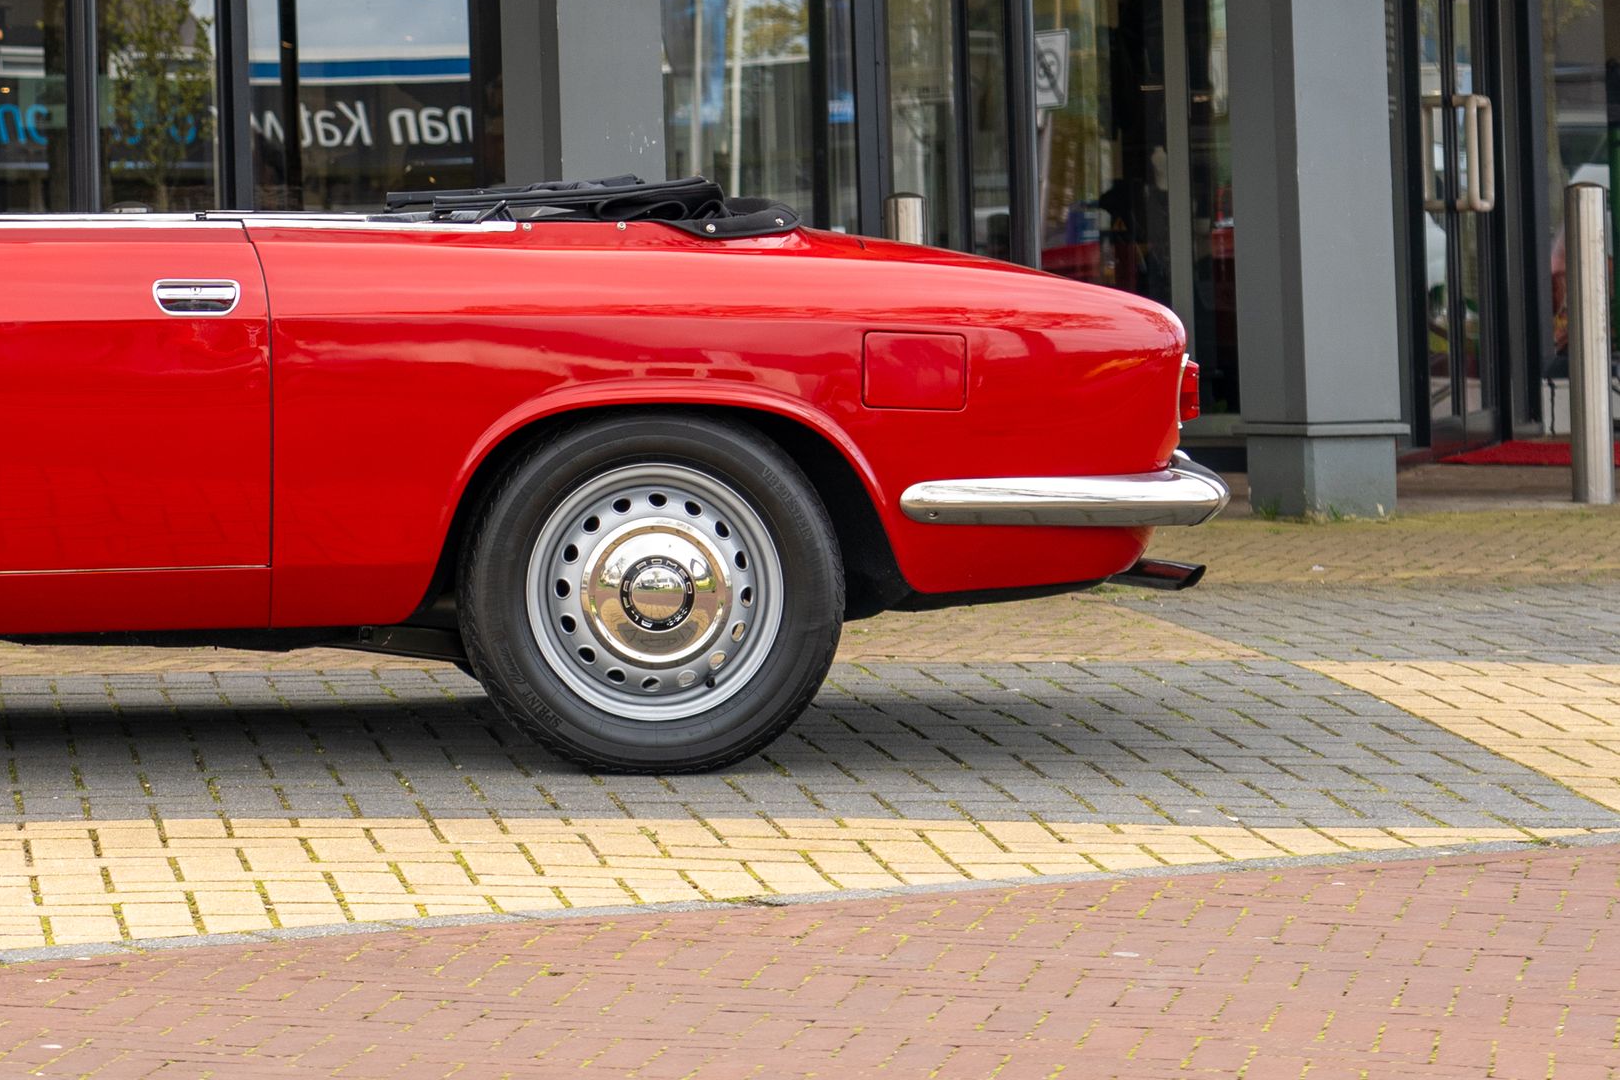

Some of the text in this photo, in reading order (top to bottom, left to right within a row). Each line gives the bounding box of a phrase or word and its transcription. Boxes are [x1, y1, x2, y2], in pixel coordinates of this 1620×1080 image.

[622, 558, 693, 629] ALFA ROMEO
[521, 689, 564, 729] SPRINT
